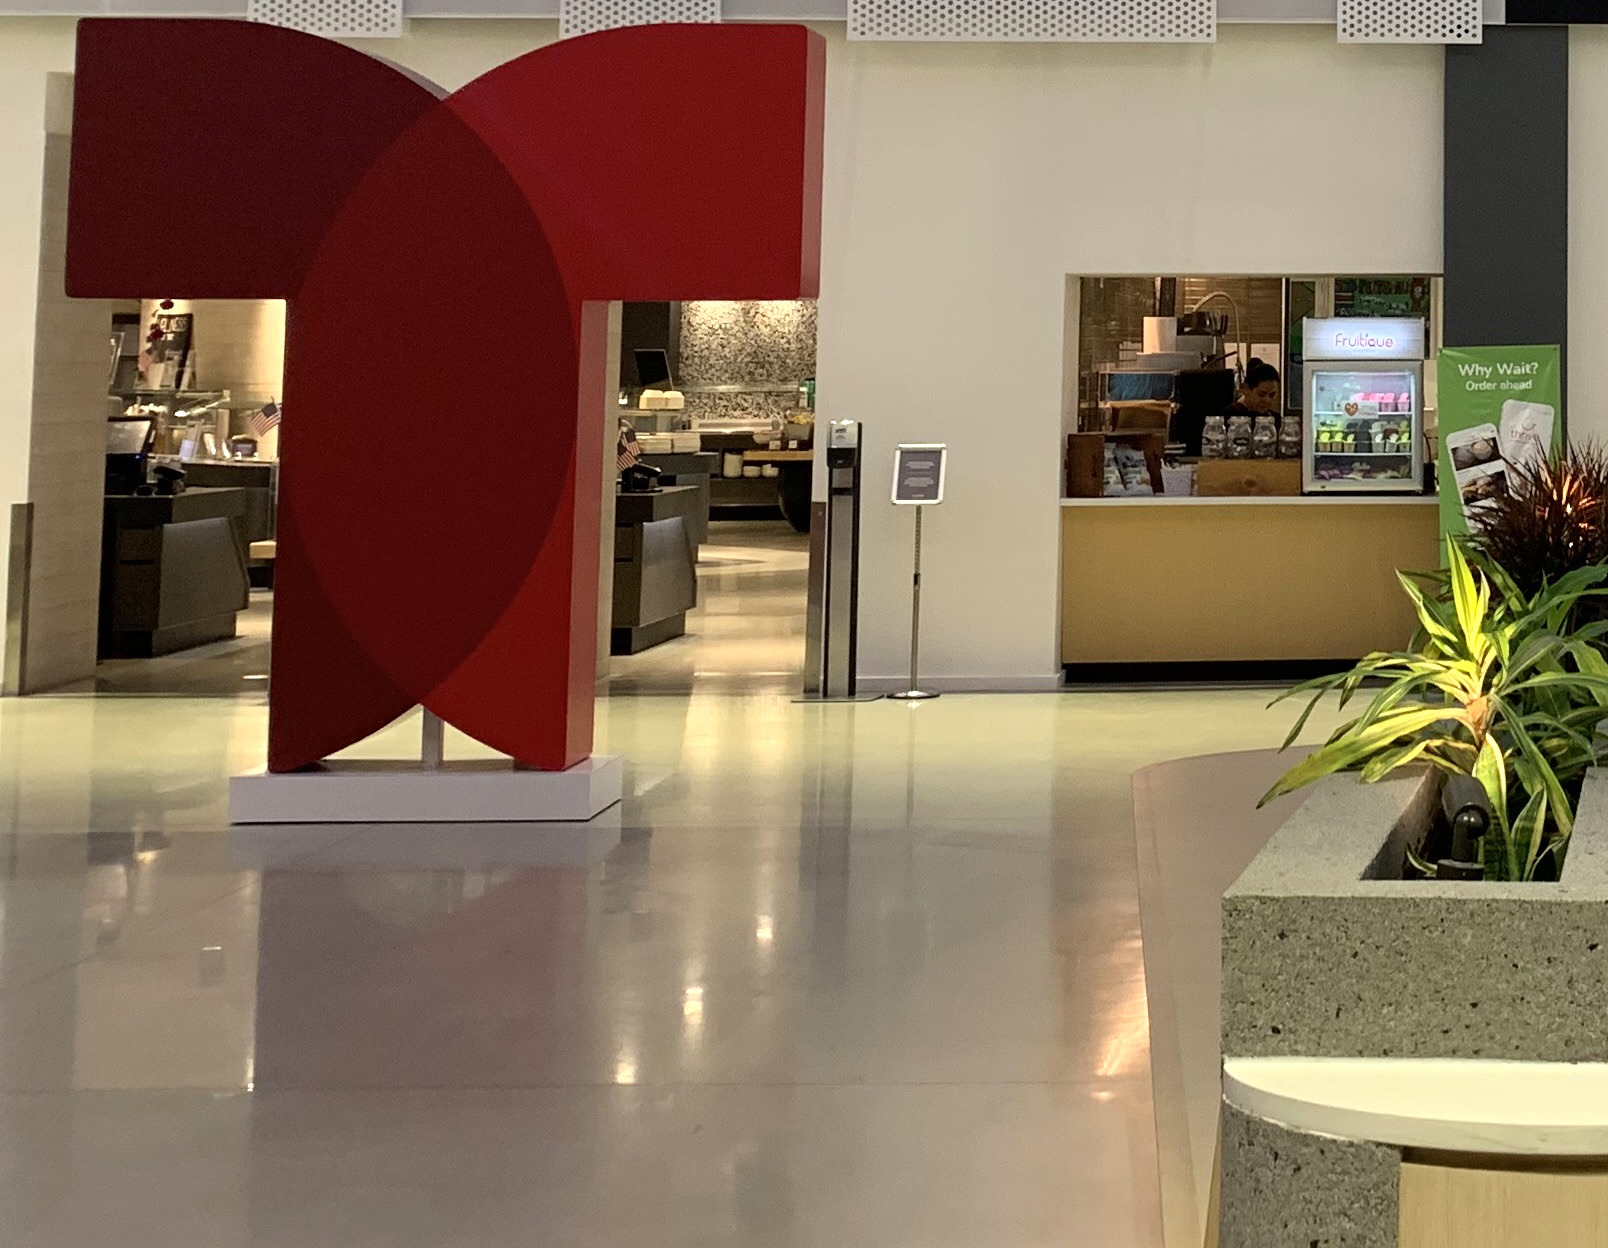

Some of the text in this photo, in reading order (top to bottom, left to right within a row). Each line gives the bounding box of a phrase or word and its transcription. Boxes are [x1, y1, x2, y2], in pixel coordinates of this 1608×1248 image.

[1458, 362, 1539, 379] Why Wait?
[1465, 379, 1533, 391] Order ahead
